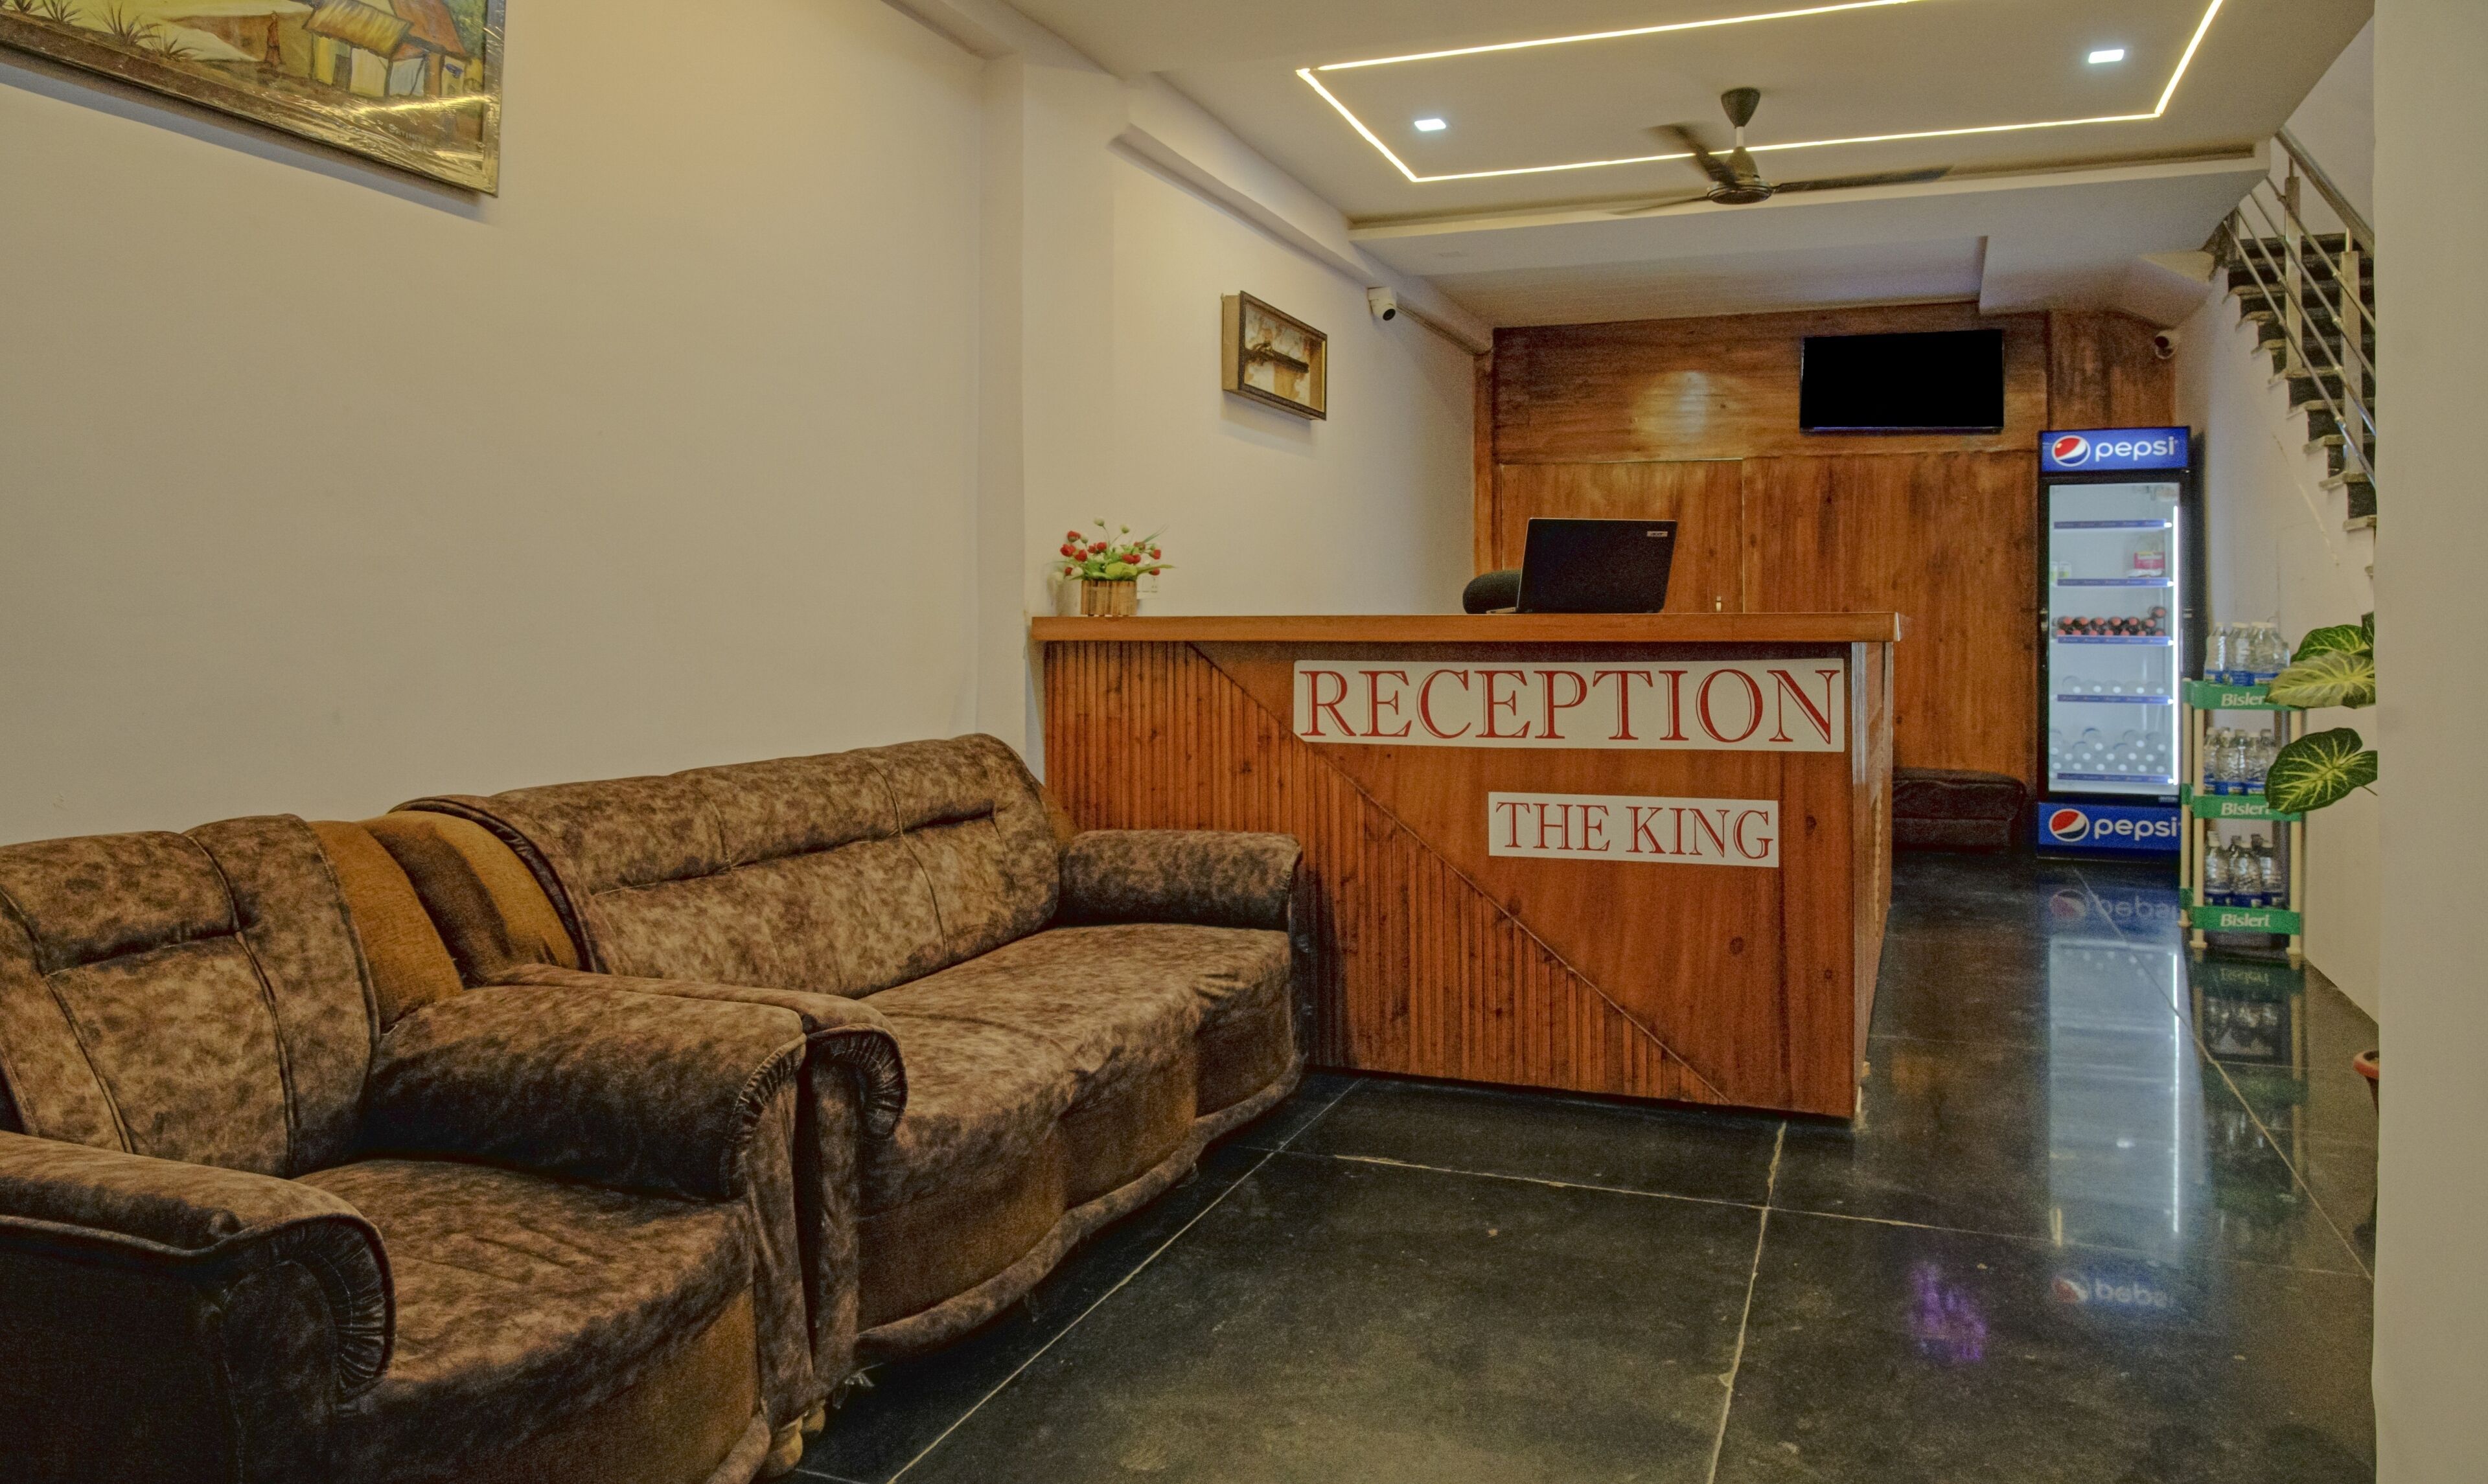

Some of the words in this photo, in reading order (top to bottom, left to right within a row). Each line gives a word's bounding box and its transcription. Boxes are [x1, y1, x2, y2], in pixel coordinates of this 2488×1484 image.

[2095, 436, 2174, 462] pepsi
[1298, 668, 1841, 745] RECEPTION
[2221, 692, 2271, 707] Bisler
[2220, 802, 2271, 816] Bisleri
[1495, 801, 1611, 854] THE
[1626, 806, 1774, 860] KING
[2094, 816, 2177, 841] pepsi
[2220, 913, 2270, 928] Bisleri
